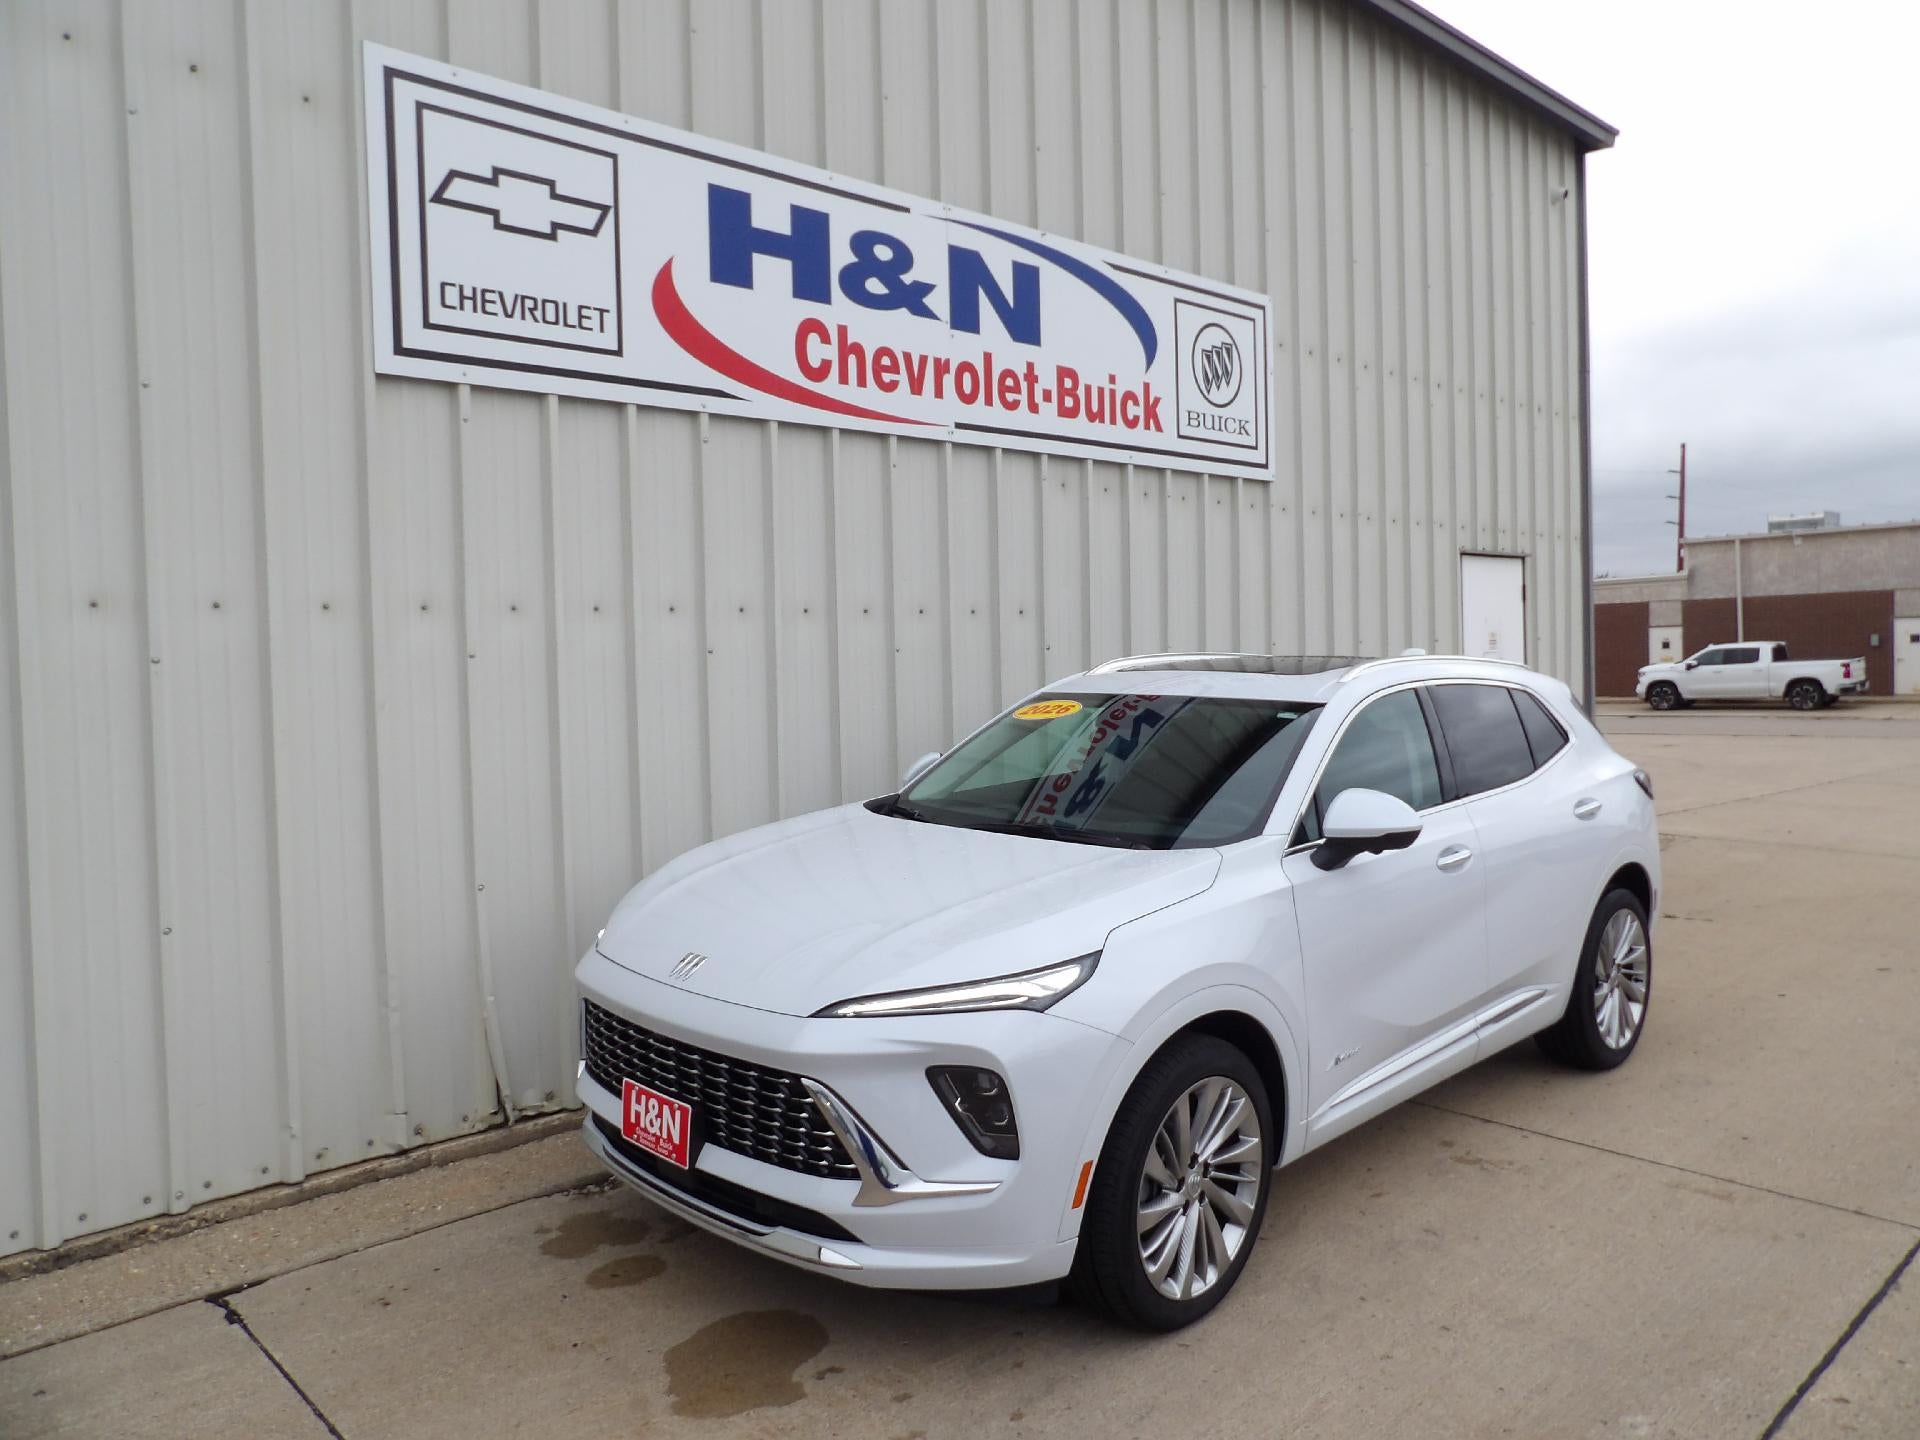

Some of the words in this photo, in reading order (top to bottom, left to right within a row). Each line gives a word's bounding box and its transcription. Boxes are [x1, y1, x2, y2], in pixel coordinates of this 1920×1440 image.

[708, 182, 1041, 347] H&N
[440, 281, 610, 333] CHEVROLET
[795, 317, 1163, 433] Chevrolet-Buick
[1186, 410, 1251, 436] BUICK
[1018, 704, 1077, 715] 2026
[630, 1088, 681, 1145] H&N
